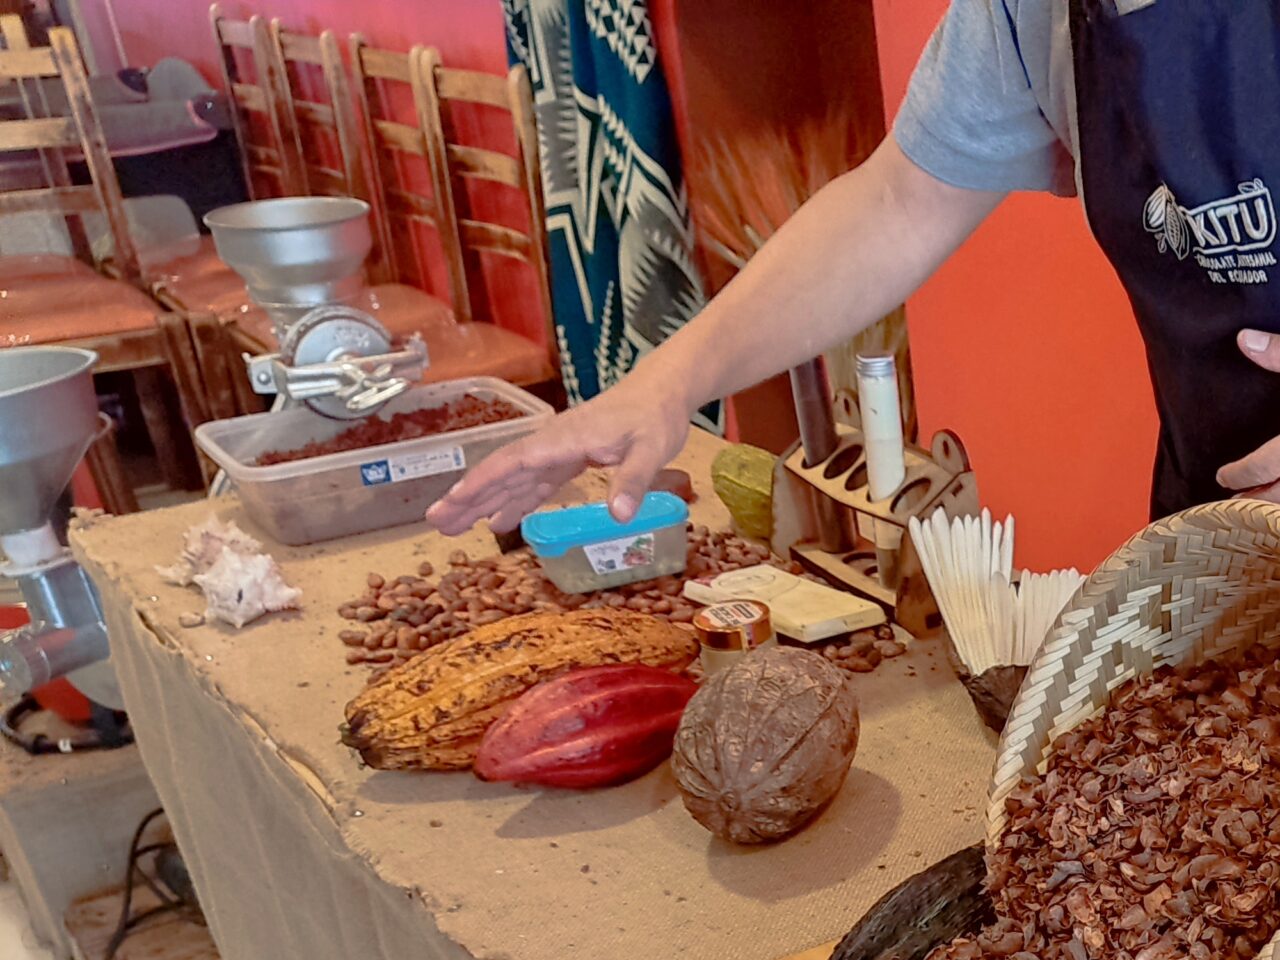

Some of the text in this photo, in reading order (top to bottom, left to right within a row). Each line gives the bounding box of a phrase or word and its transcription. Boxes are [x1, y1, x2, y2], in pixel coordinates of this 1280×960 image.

[1187, 197, 1268, 248] KITU
[1207, 269, 1268, 284] DEL ECUADOR
